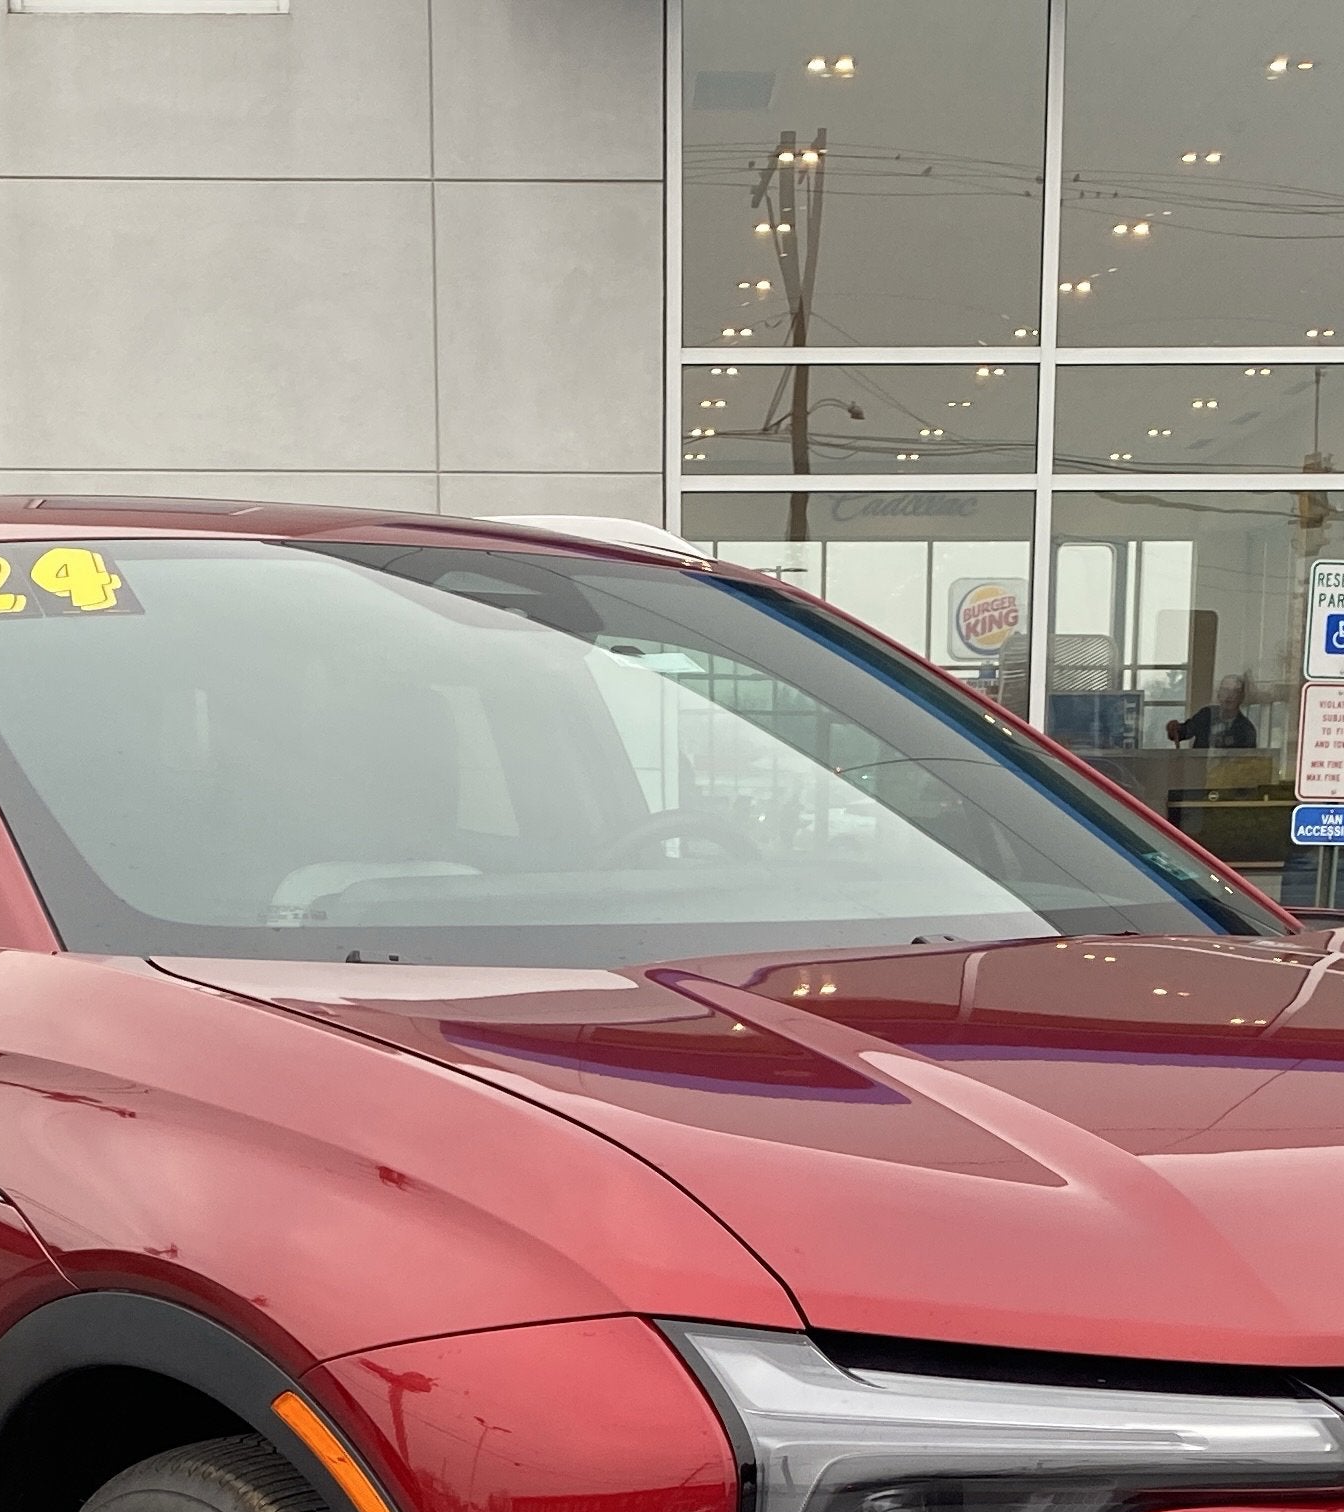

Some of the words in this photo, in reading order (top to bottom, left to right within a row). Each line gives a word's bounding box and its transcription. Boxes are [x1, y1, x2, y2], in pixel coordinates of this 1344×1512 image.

[829, 495, 978, 521] Cadillac
[963, 596, 1016, 622] BURGER
[965, 608, 1019, 640] KING
[1322, 727, 1332, 736] TO
[1314, 741, 1330, 749] AND
[1324, 774, 1340, 782] FINE
[1321, 814, 1343, 824] VAN
